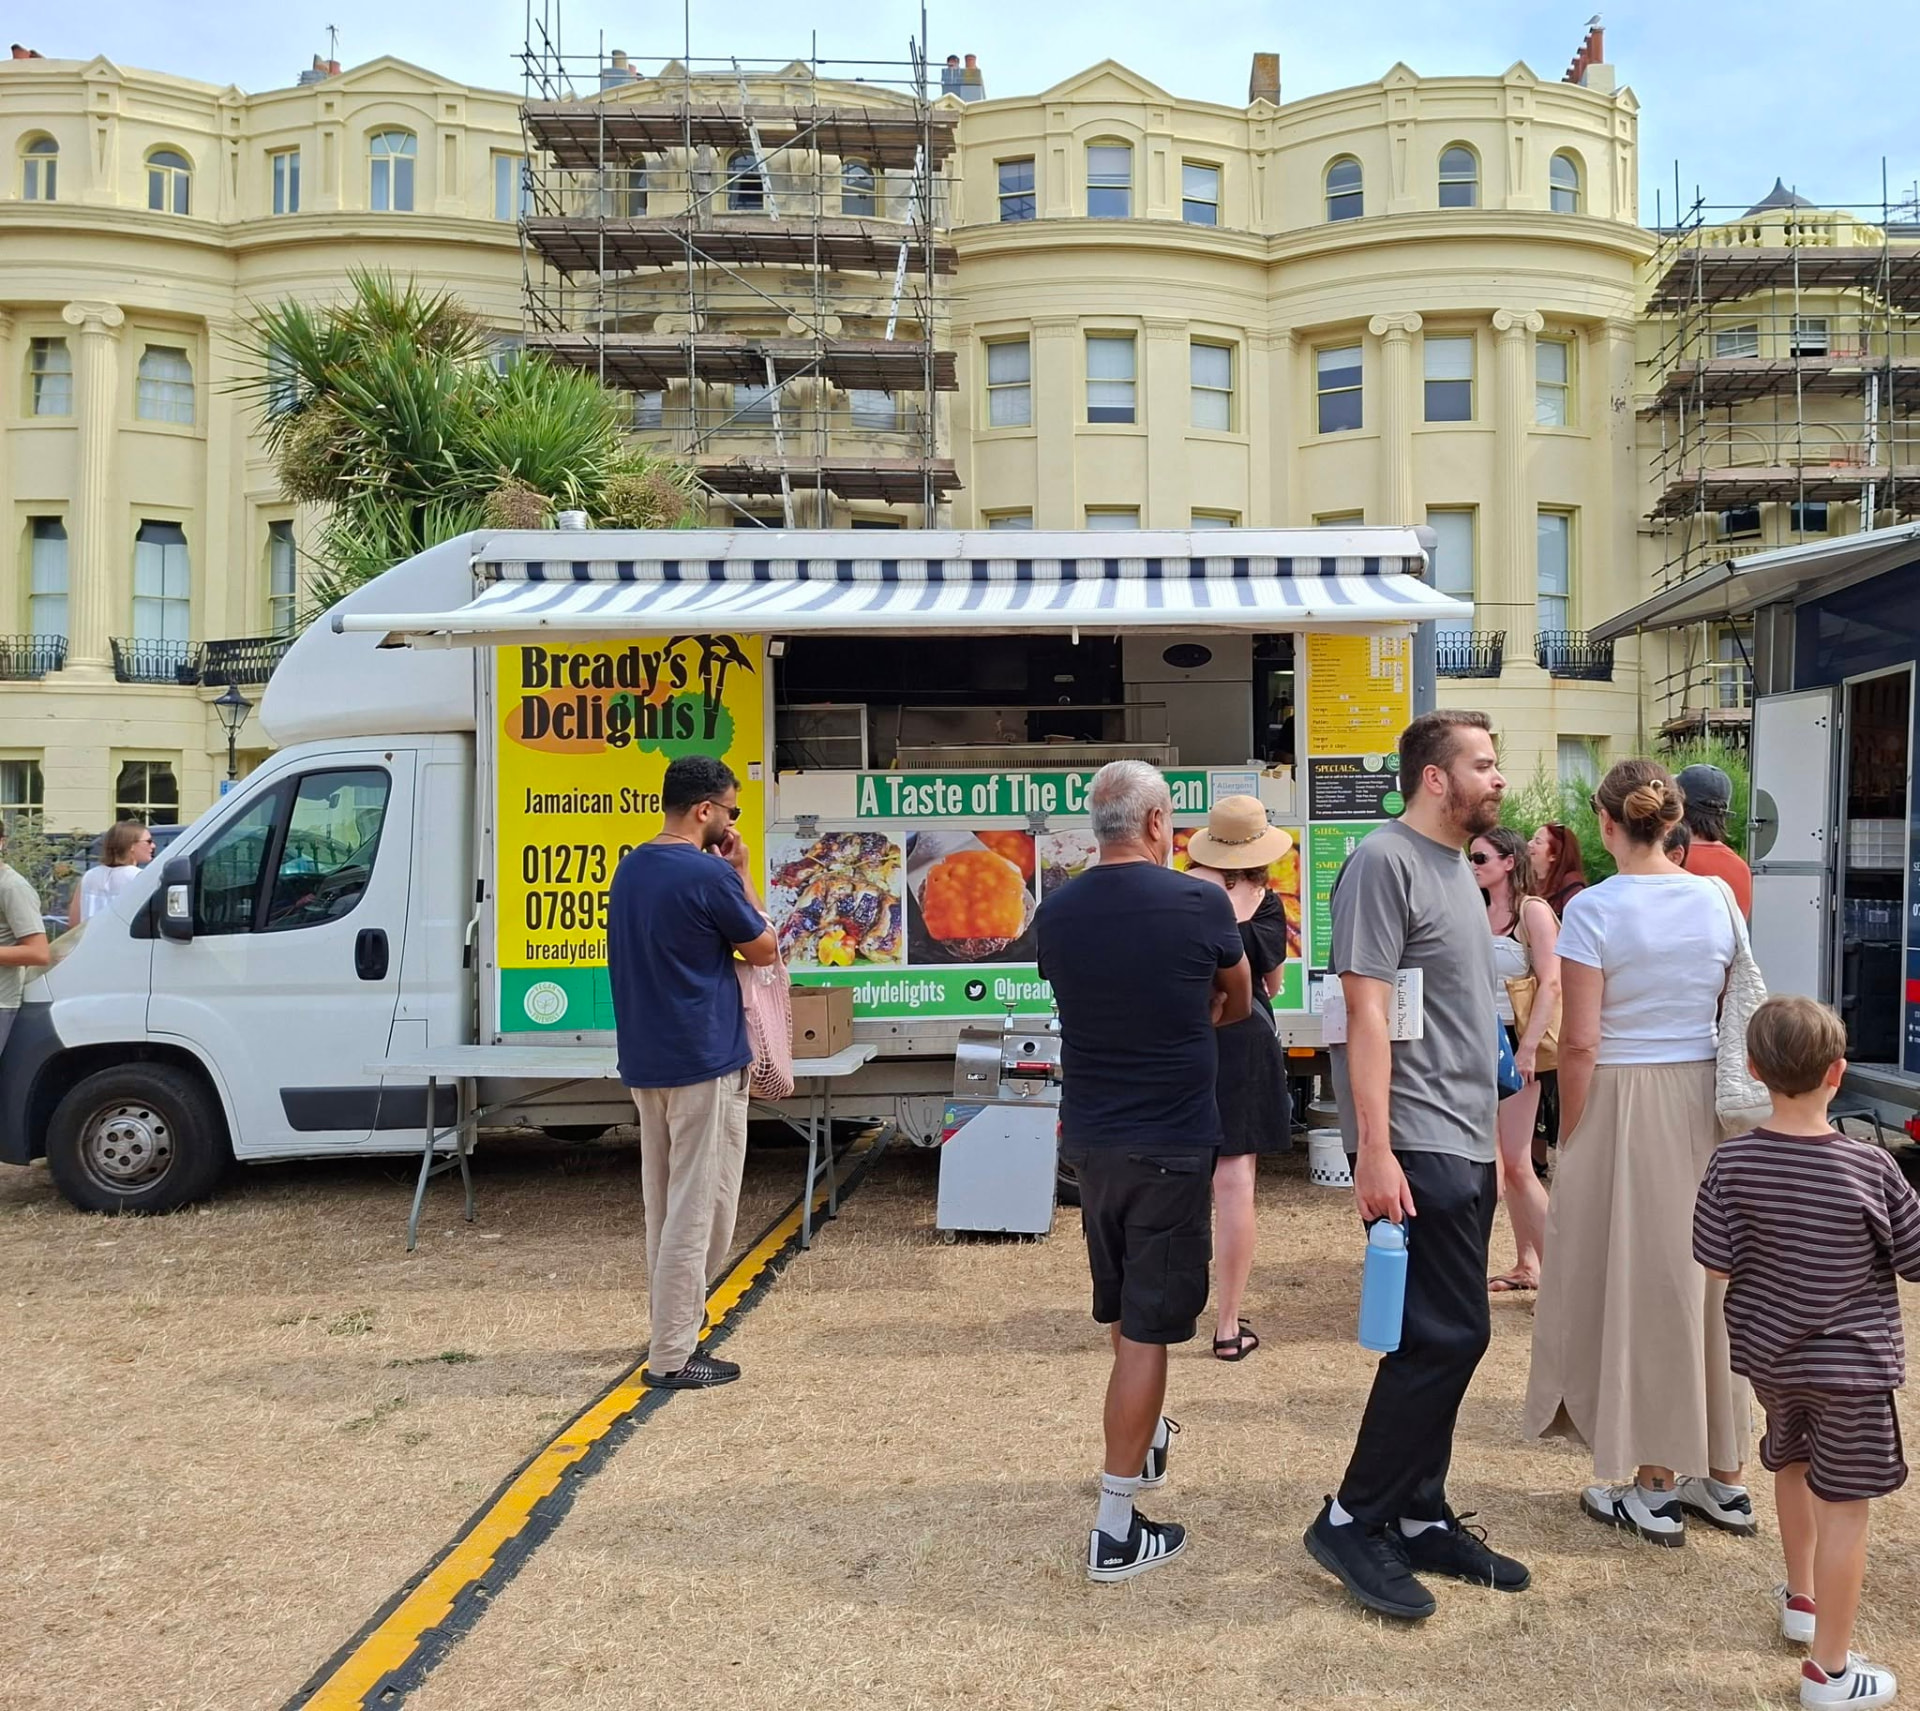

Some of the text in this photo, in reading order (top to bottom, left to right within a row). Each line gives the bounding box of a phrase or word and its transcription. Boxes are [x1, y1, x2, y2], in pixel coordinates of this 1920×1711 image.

[521, 646, 688, 698] Bready's
[521, 694, 695, 748] Delights
[525, 788, 665, 814] Jamaican Stre
[860, 777, 879, 817] A
[886, 775, 964, 816] Taste
[971, 774, 999, 814] of
[1006, 774, 1057, 812] The
[522, 845, 606, 884] 01273
